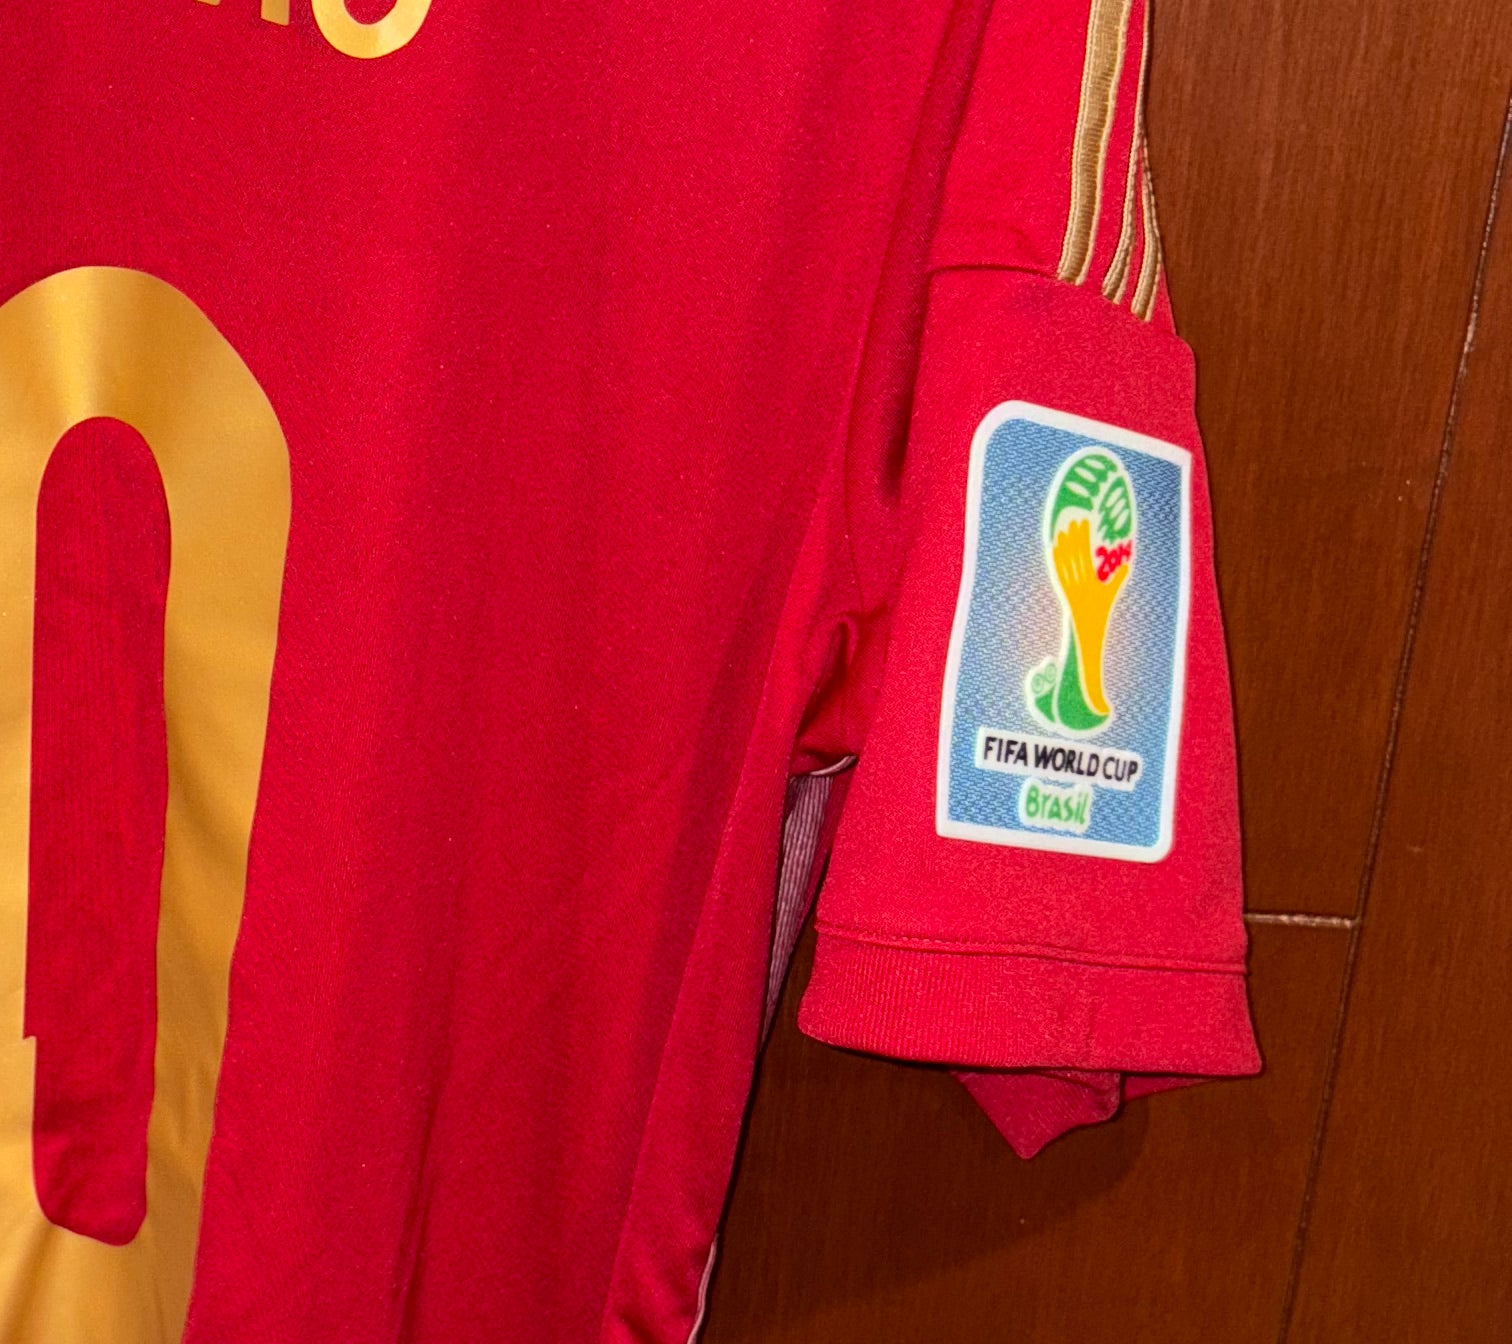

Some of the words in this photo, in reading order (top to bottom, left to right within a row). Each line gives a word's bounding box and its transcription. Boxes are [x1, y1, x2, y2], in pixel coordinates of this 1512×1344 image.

[983, 736, 1028, 766] FIFA
[1034, 743, 1100, 777] WORLD
[1103, 757, 1139, 783] CUP
